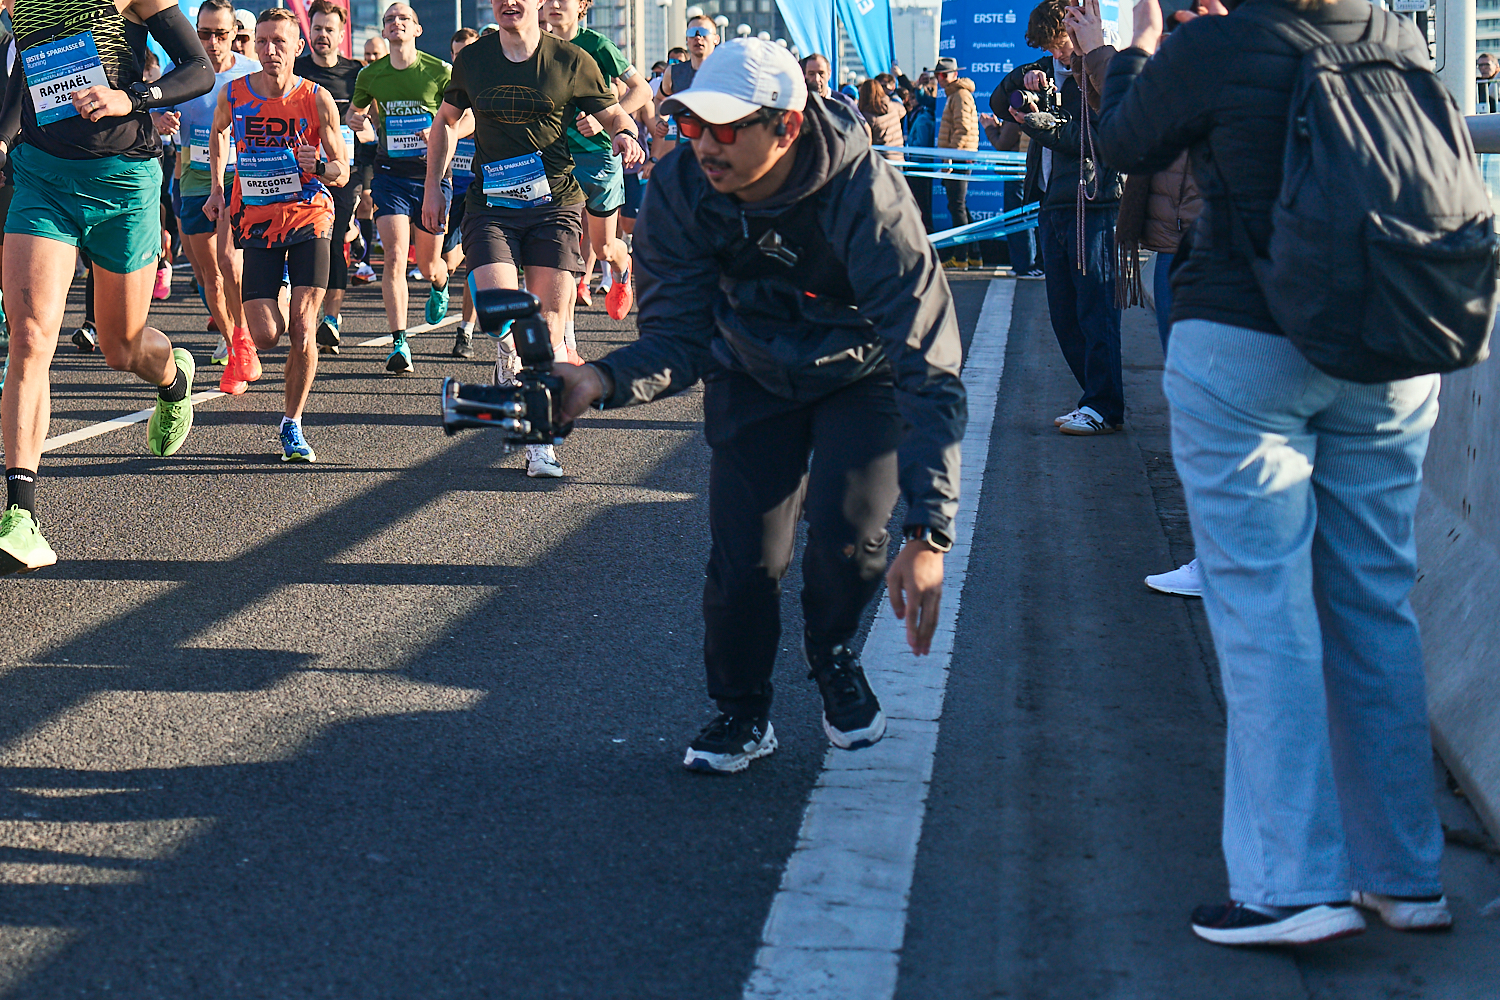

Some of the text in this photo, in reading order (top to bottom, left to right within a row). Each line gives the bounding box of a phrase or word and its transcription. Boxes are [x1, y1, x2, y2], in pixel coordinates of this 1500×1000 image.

[64, 9, 105, 28] SCOTT
[974, 13, 1004, 24] ERSTE
[972, 41, 1015, 49] #glaubandich
[25, 42, 79, 63] ERSTE SPARKASSE
[27, 59, 46, 69] Running
[971, 62, 1001, 73] ERSTE
[39, 75, 91, 98] RAPHAËL
[55, 92, 73, 104] 282
[245, 116, 296, 137] EDI
[244, 136, 296, 147] TEAM
[247, 177, 292, 187] GRZEGORZ
